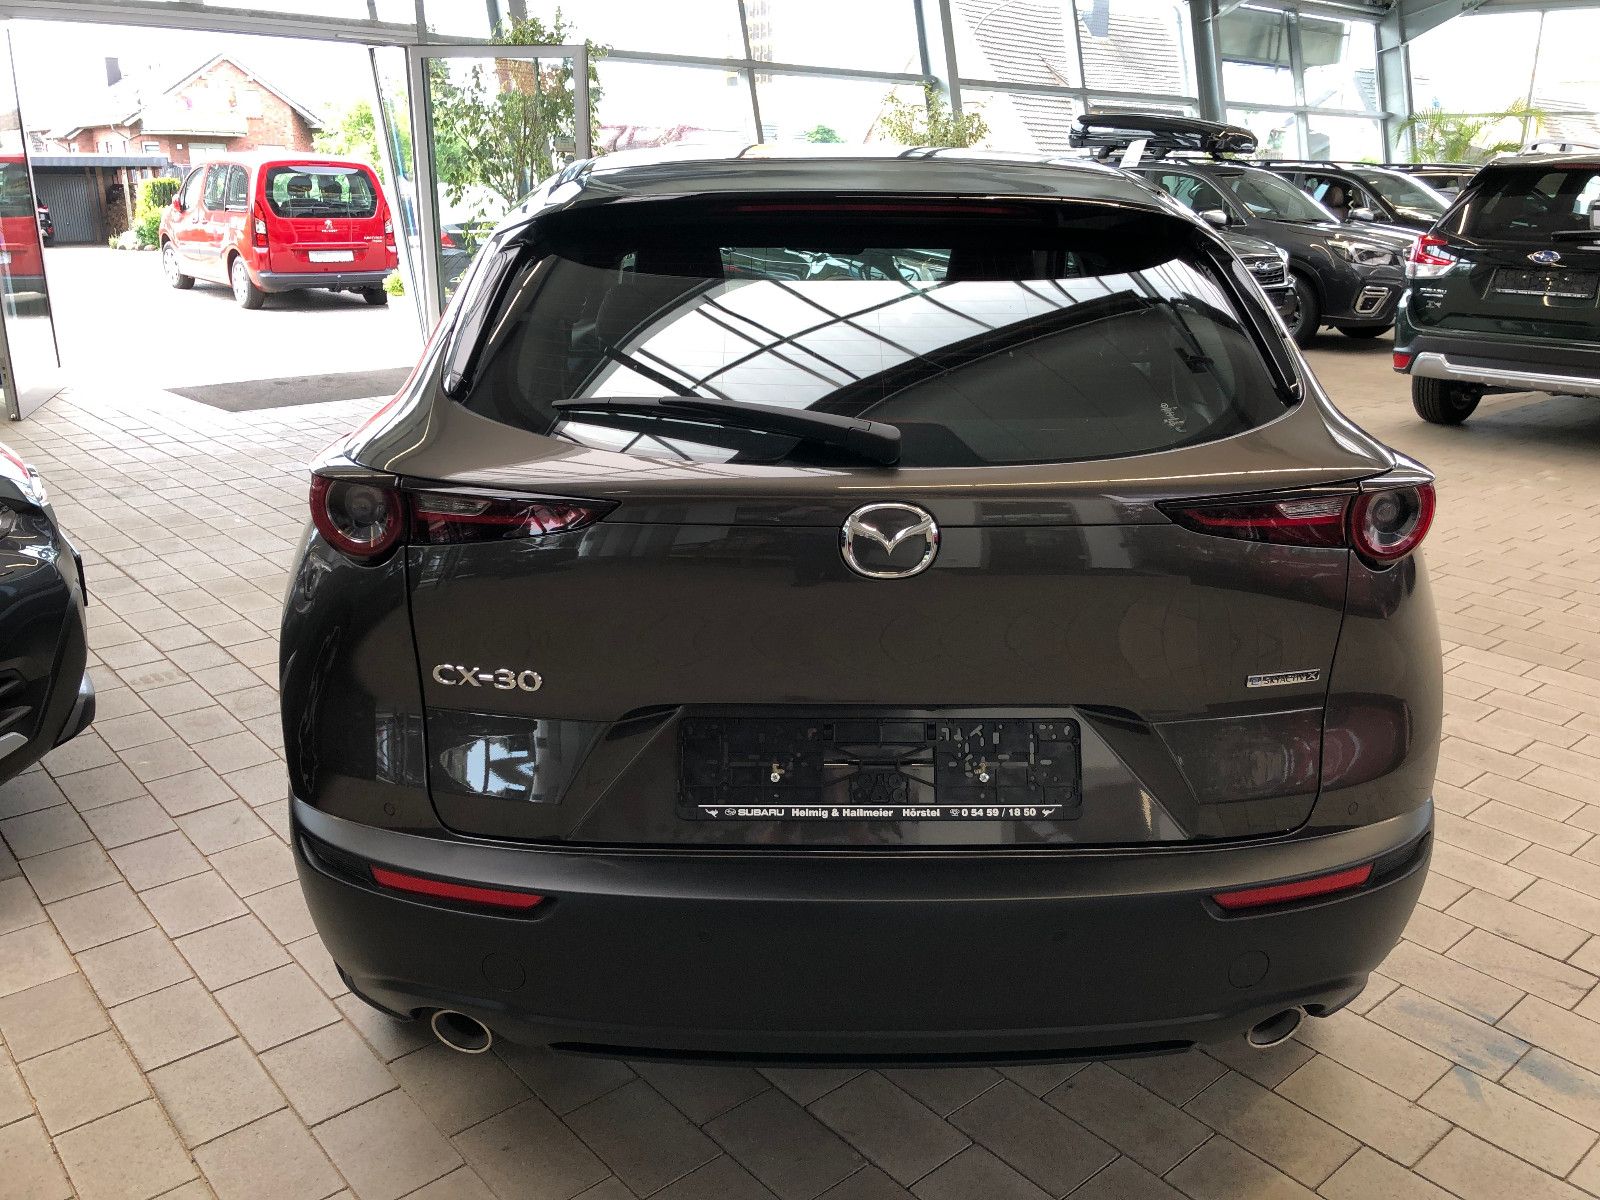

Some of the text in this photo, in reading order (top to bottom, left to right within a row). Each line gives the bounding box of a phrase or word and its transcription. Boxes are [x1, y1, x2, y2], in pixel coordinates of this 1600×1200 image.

[432, 663, 543, 692] CX-30
[737, 808, 785, 817] SUBARU
[791, 808, 829, 818] Helmig
[831, 808, 840, 817] &
[842, 808, 894, 817] Hallmeier
[902, 807, 941, 817] Hörstel
[970, 808, 984, 817] 54
[986, 808, 999, 817] 59
[1008, 808, 1021, 817] 18
[1023, 808, 1037, 817] 50
